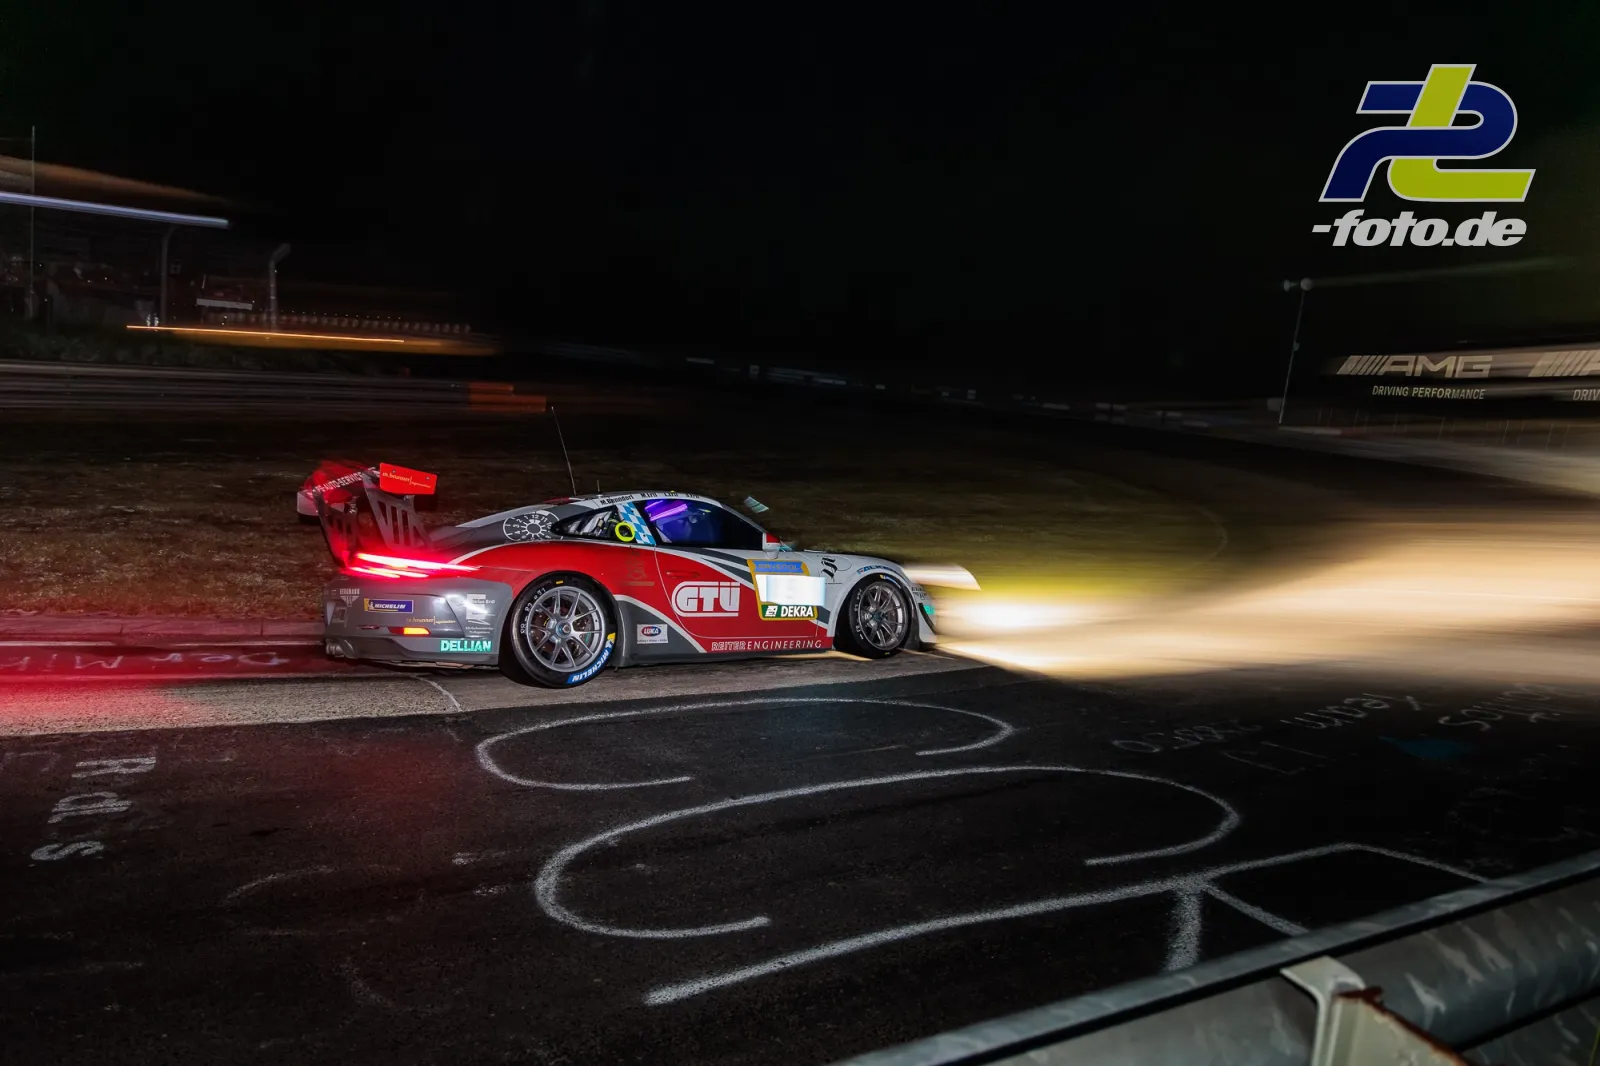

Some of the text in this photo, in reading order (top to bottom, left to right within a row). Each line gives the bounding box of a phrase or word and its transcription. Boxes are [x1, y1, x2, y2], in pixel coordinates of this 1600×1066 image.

[1380, 355, 1493, 378] AMG
[1372, 385, 1486, 400] DRIVING PERFORMANCE
[672, 581, 740, 616] GTÜ
[780, 605, 814, 618] DEKRA
[440, 640, 492, 652] DELLIAN
[572, 650, 610, 683] MICHELIN
